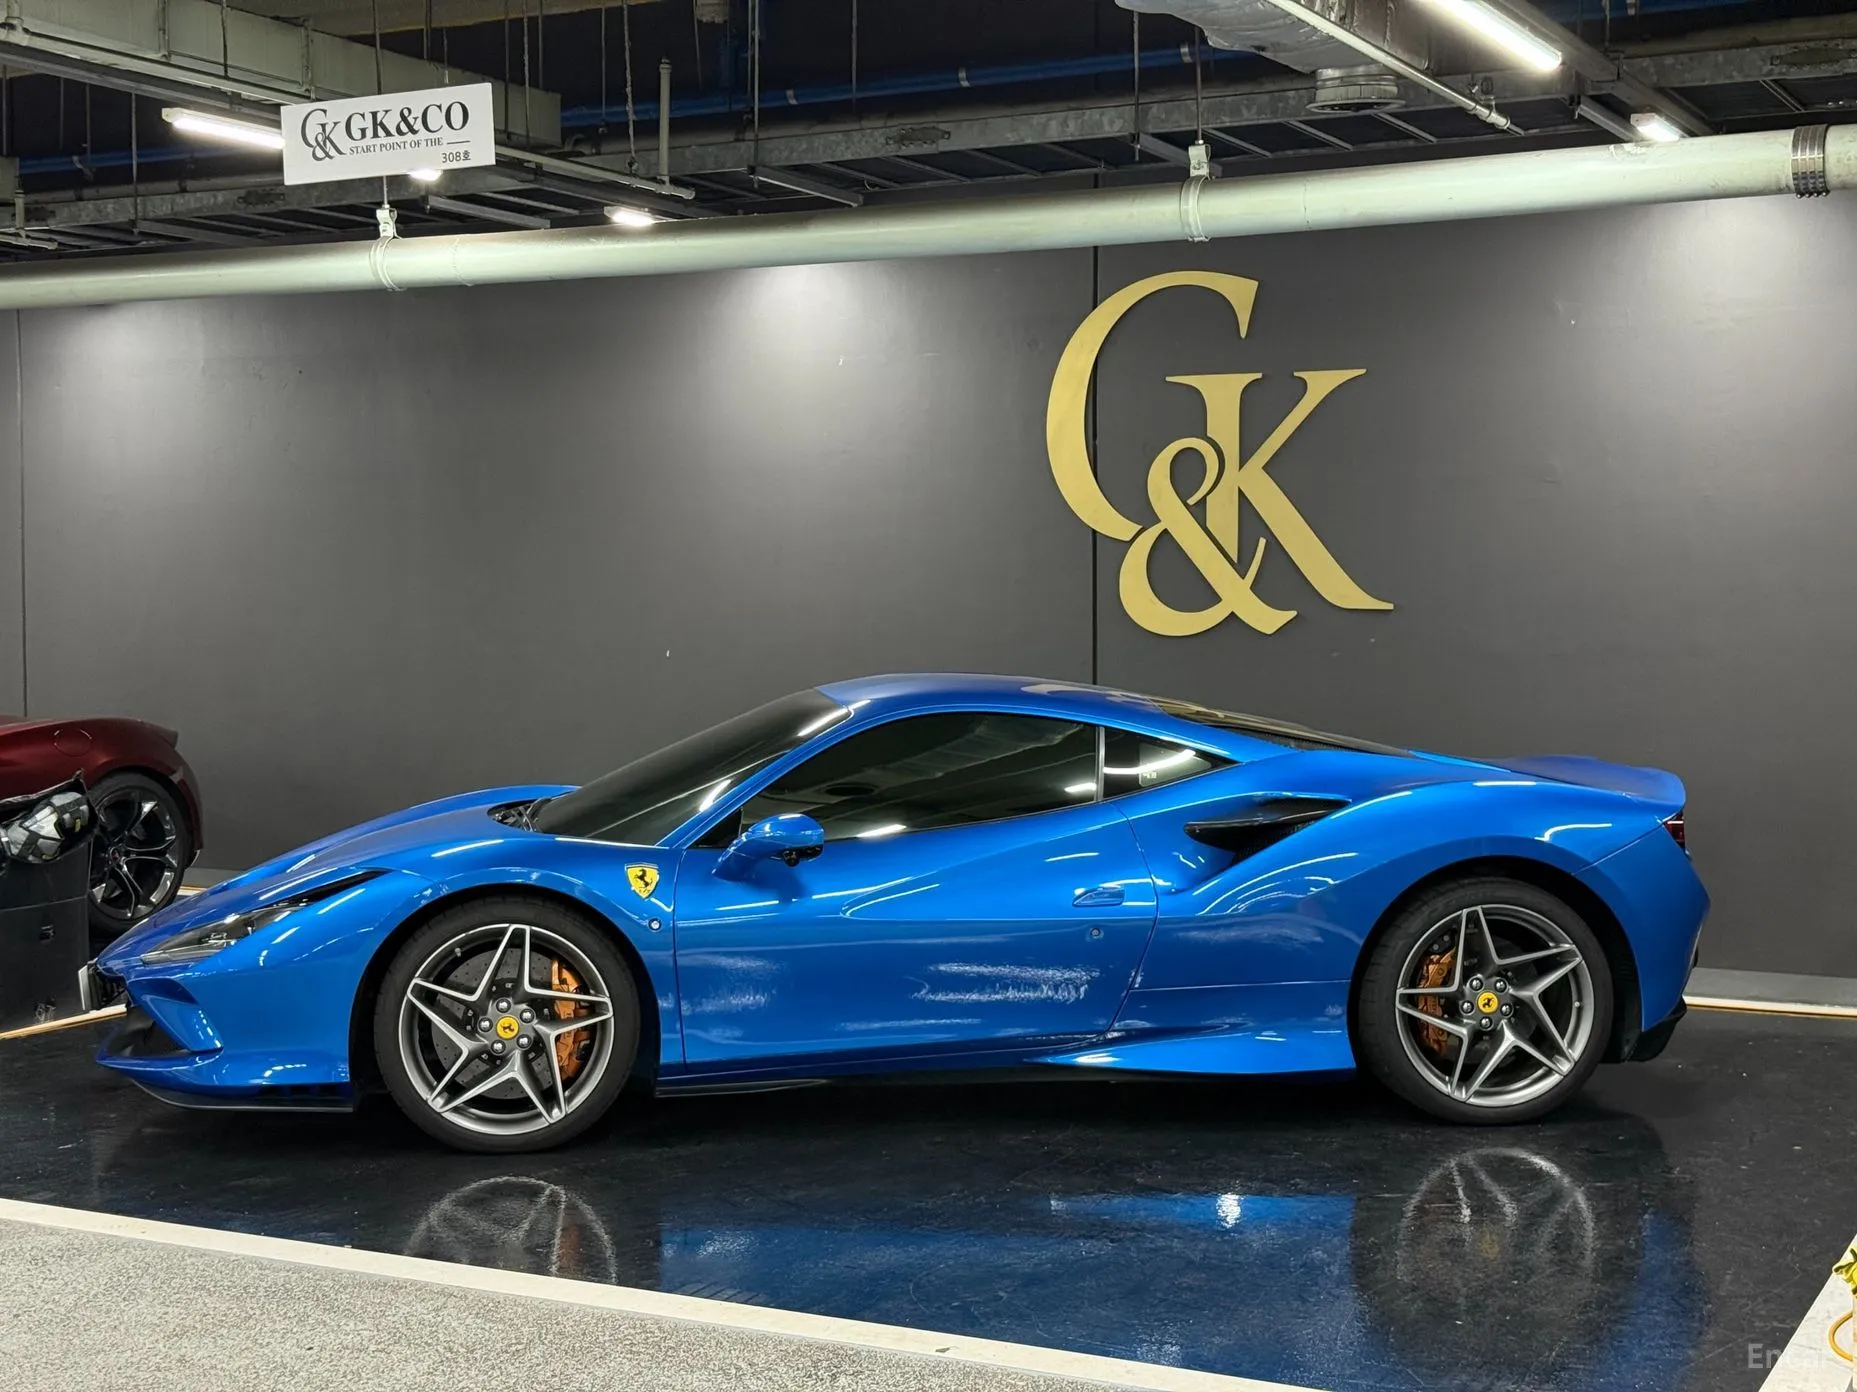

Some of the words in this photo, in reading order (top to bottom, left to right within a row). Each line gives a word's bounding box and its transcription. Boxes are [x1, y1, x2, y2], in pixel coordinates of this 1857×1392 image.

[345, 101, 469, 141] GK&CO
[349, 143, 378, 155] START
[379, 140, 409, 152] POINT
[409, 138, 423, 149] OF
[424, 137, 443, 147] THE
[441, 150, 471, 164] 308호
